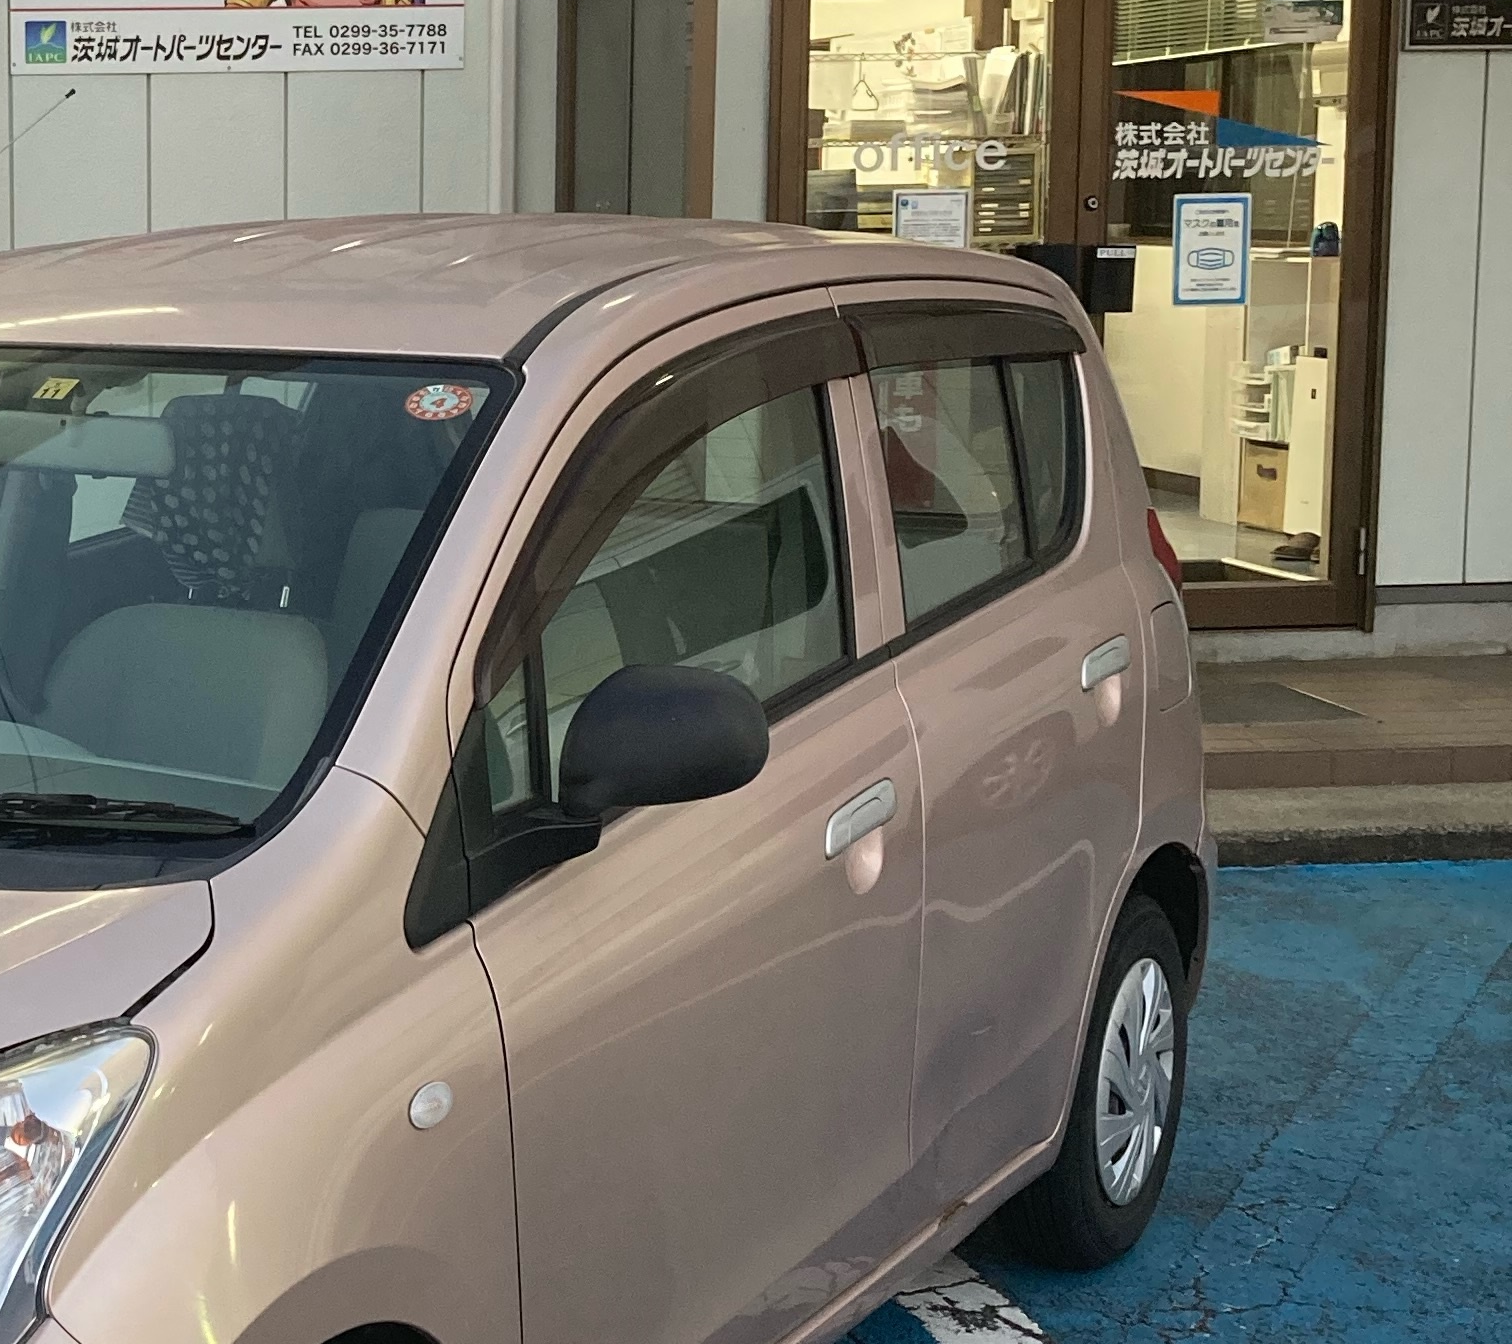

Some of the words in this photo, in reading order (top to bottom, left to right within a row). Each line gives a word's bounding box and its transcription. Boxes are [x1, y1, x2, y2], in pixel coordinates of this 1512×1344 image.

[70, 21, 117, 34] 株式会社
[292, 26, 324, 40] TEL
[329, 23, 448, 39] 0299-35-7788
[71, 34, 283, 63] 茨城オートパーツセンター
[292, 43, 324, 57] FAX
[329, 41, 447, 56] 0299-36-7171
[1114, 121, 1210, 146] 株式会社
[853, 131, 1008, 172] office
